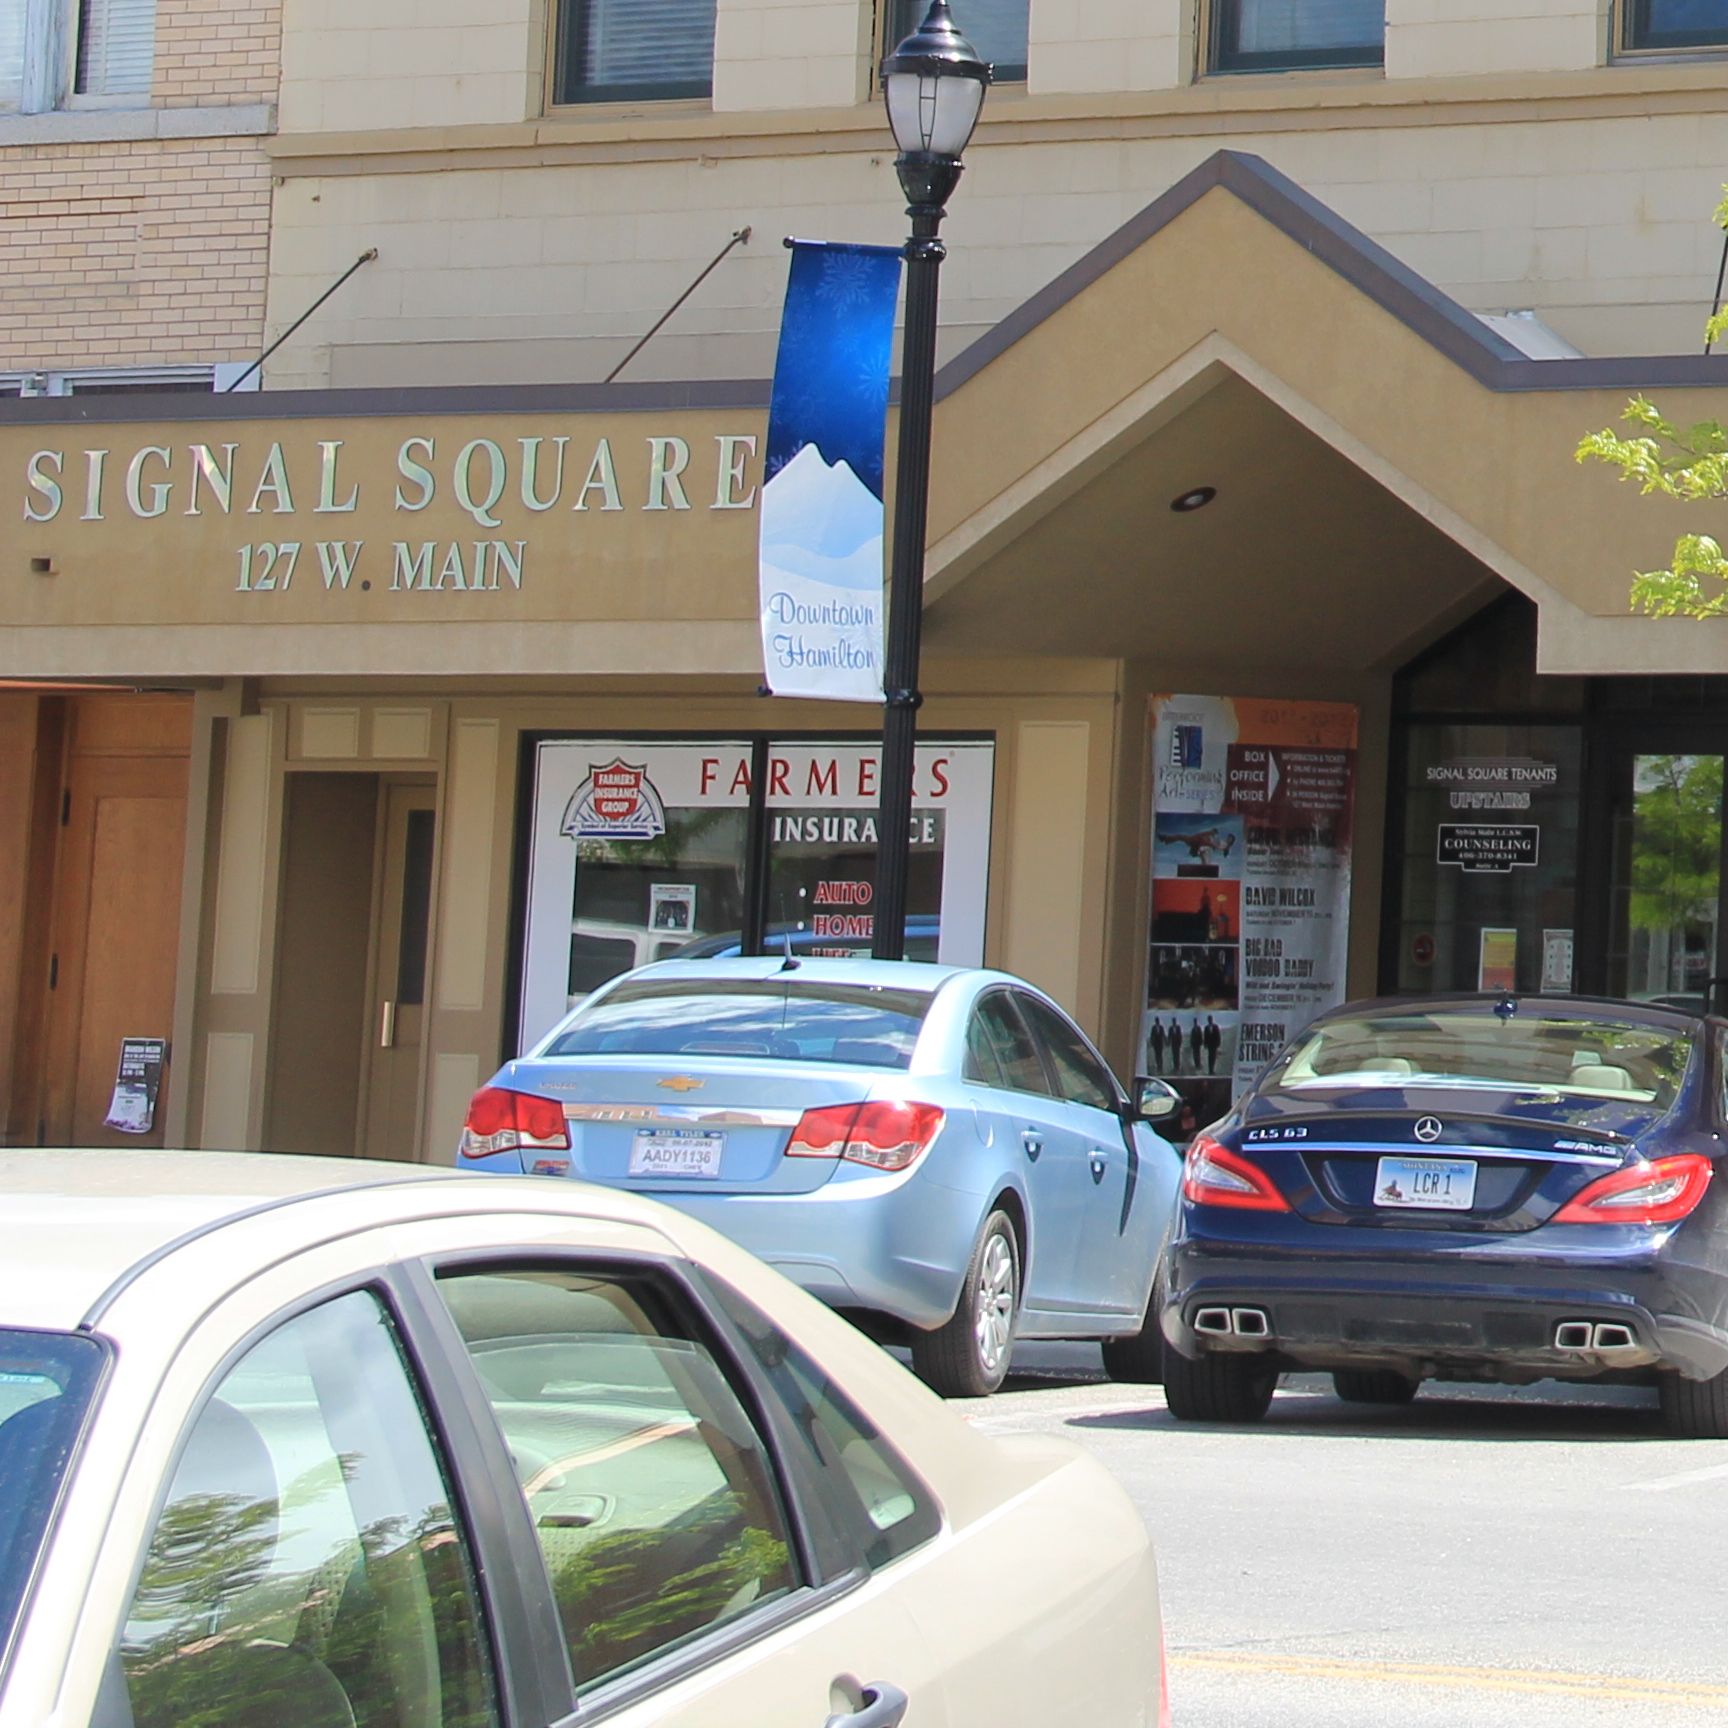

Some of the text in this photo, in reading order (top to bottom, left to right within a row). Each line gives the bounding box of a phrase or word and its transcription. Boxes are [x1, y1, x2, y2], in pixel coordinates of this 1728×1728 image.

[23, 434, 759, 528] SIGNAL SQUARE
[235, 542, 301, 591] 127
[388, 540, 528, 591] MAIN
[768, 591, 874, 626] Downtown
[772, 634, 875, 670] Hamilton
[1244, 751, 1265, 762] BOX
[599, 773, 635, 785] FARMERS
[699, 757, 950, 798] FARMES
[1230, 770, 1265, 782] OFFICE
[1426, 767, 1557, 780] SIGNAL SQUARE TENANTS
[595, 787, 638, 799] INSURANCE
[1231, 789, 1265, 802] INSIDE
[1450, 791, 1530, 808] UPSTAIRS
[601, 801, 630, 812] GROUP
[774, 816, 935, 844] INSURACE
[1444, 838, 1532, 851] COUNSELING
[813, 881, 873, 905] AUTO
[1246, 887, 1316, 907] DAVID WILCOX
[813, 914, 874, 938] HOME
[1245, 939, 1282, 957] BIG BAD
[1241, 1024, 1285, 1041] EMERSON
[1248, 1127, 1308, 1140] CLS 63
[642, 1149, 712, 1164] AADY1136
[1574, 1142, 1617, 1155] AMG
[1413, 1172, 1451, 1195] LCR 1
